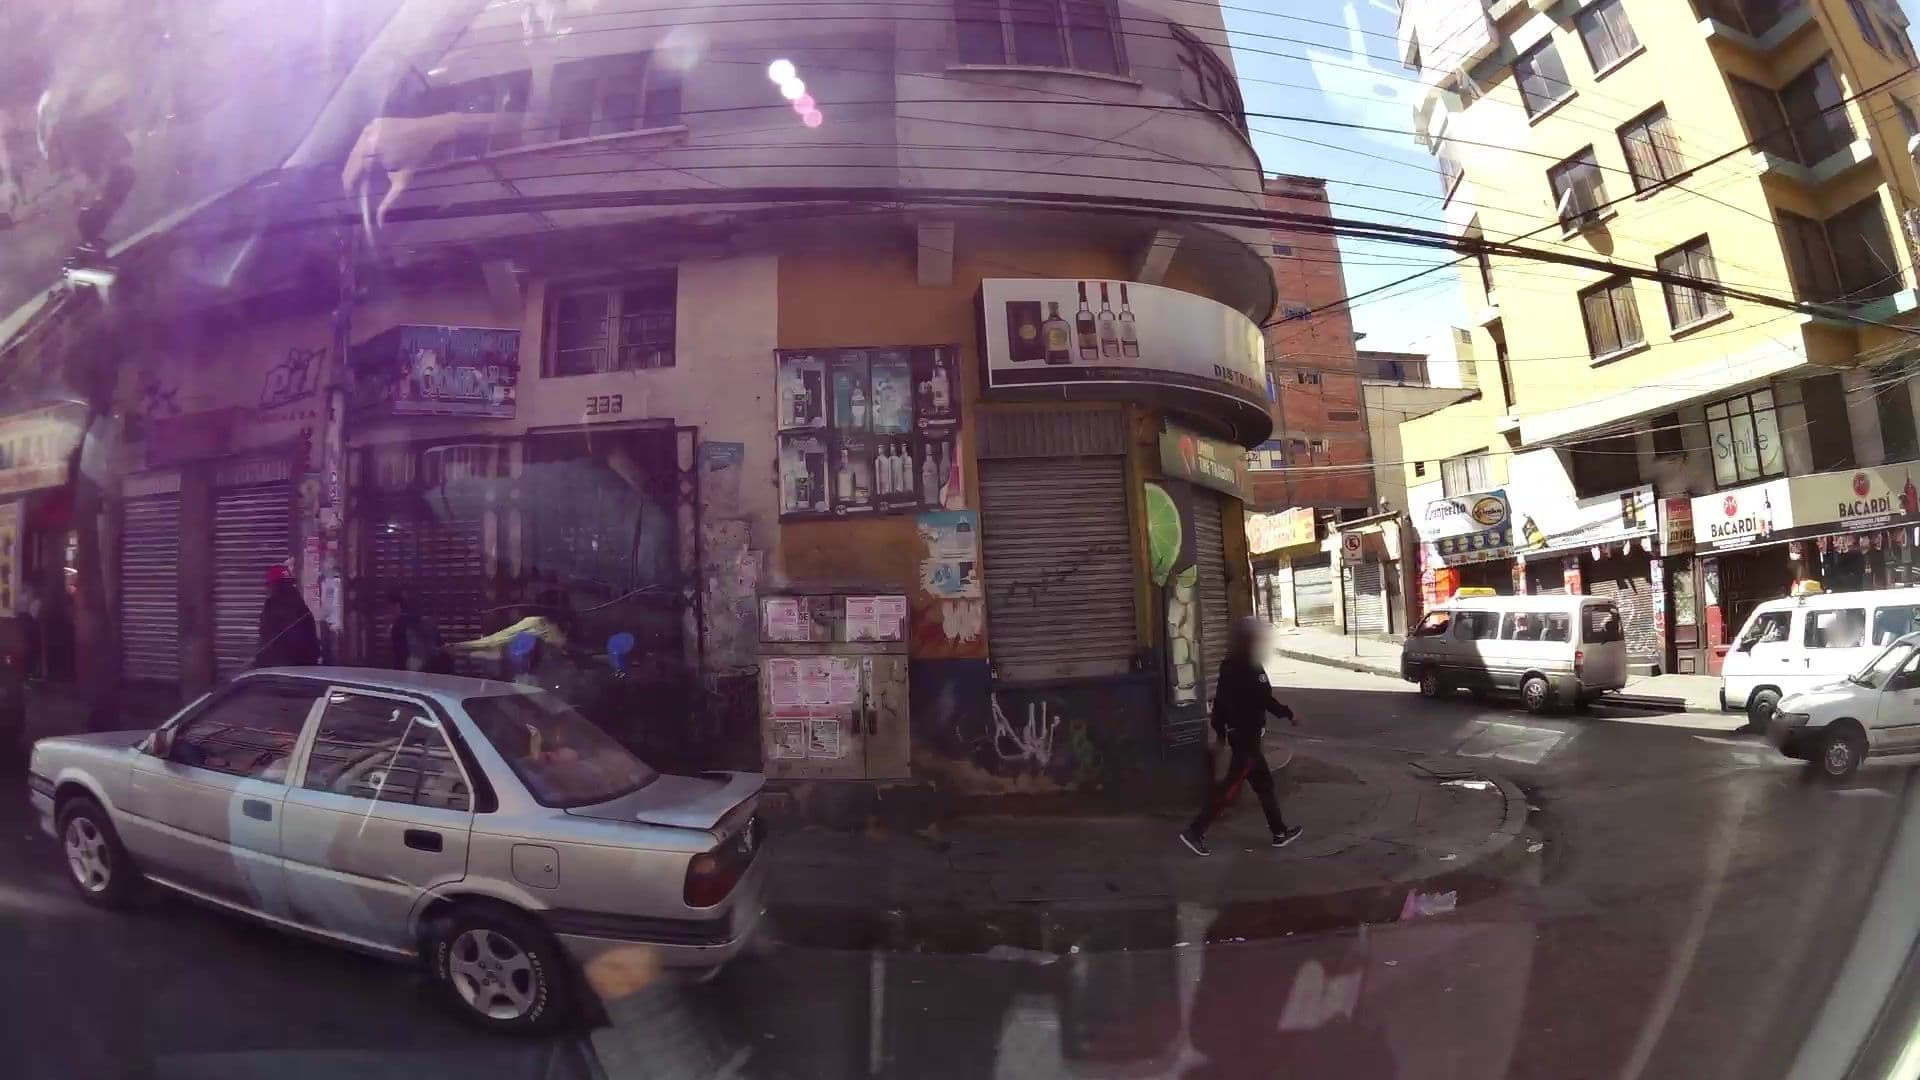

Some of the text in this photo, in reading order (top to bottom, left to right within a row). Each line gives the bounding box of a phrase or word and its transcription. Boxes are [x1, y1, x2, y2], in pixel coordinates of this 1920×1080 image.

[586, 394, 623, 415] 333
[1716, 427, 1769, 459] Smile
[1839, 492, 1890, 518] BACARDÍ
[1711, 513, 1757, 538] BACARDÍ
